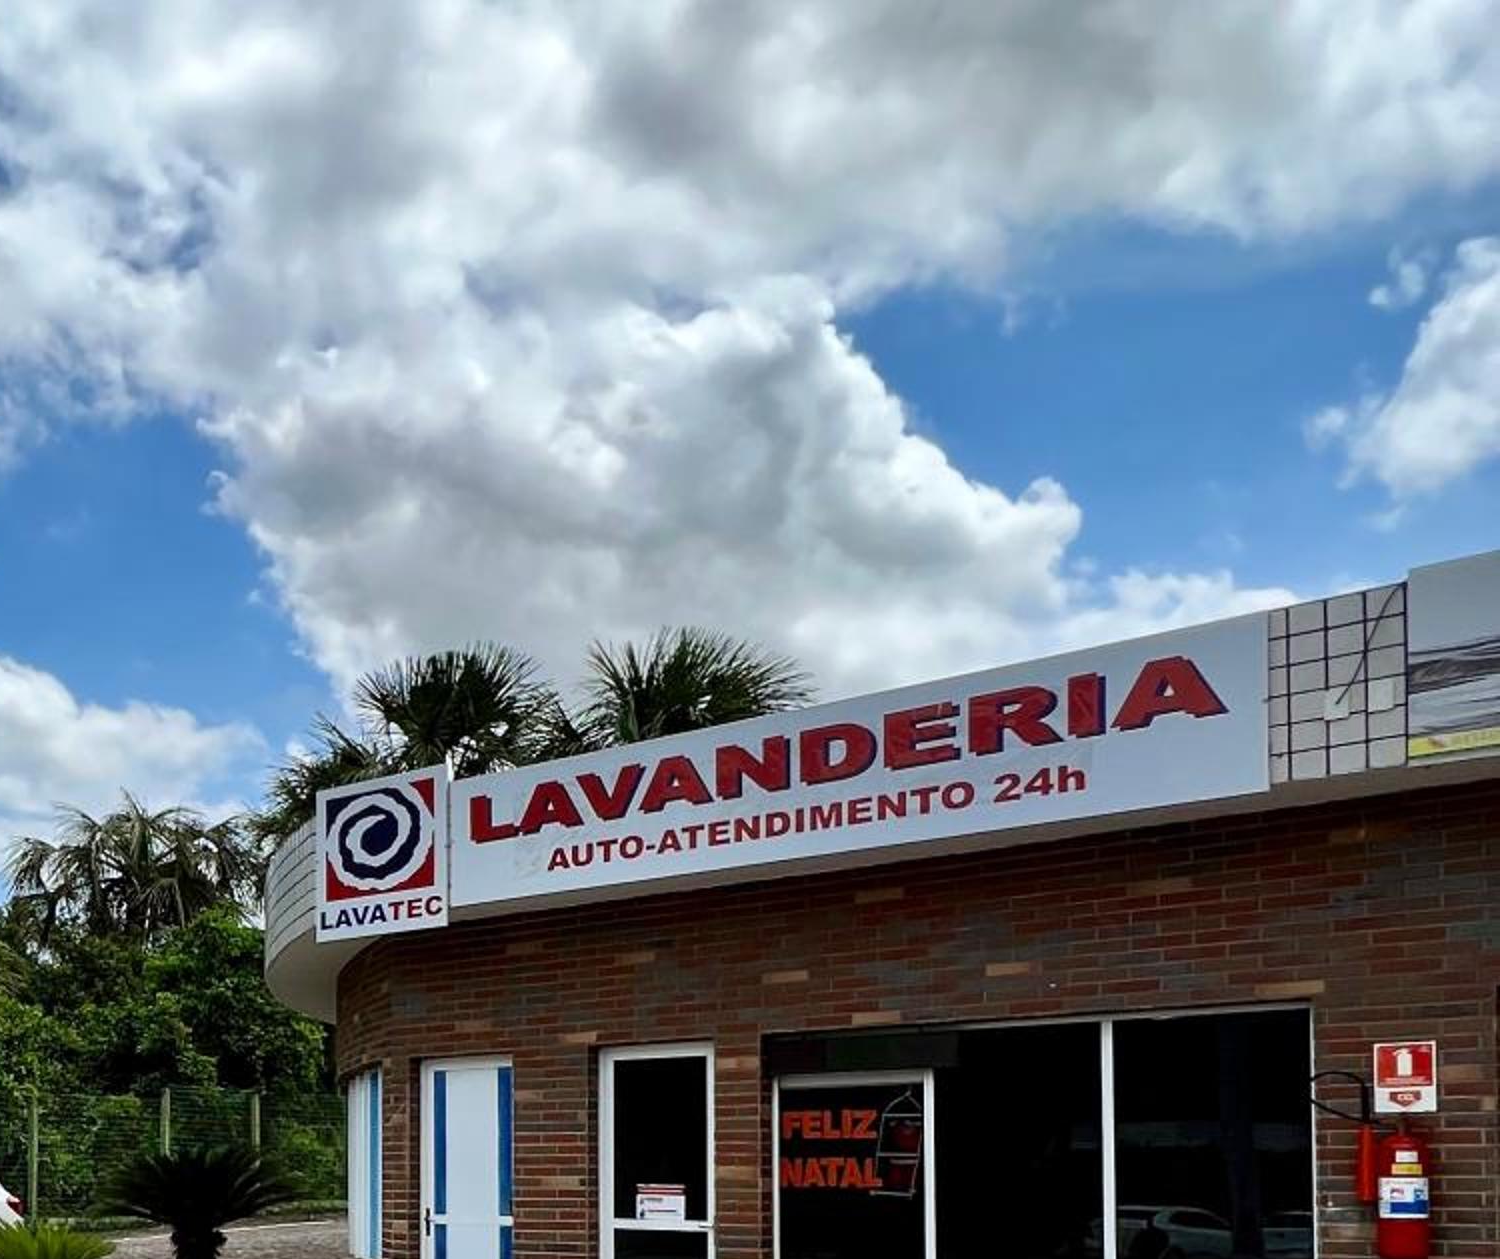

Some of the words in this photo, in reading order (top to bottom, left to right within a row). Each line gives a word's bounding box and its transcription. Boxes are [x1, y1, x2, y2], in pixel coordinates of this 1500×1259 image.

[470, 656, 1228, 846] LAVANDERIA
[547, 781, 975, 871] AUTO-ATENDIMENTO
[993, 766, 1086, 803] 24h
[320, 895, 443, 931] LAVATEC
[782, 1109, 878, 1139] FELIZ
[780, 1156, 883, 1188] NATAL
